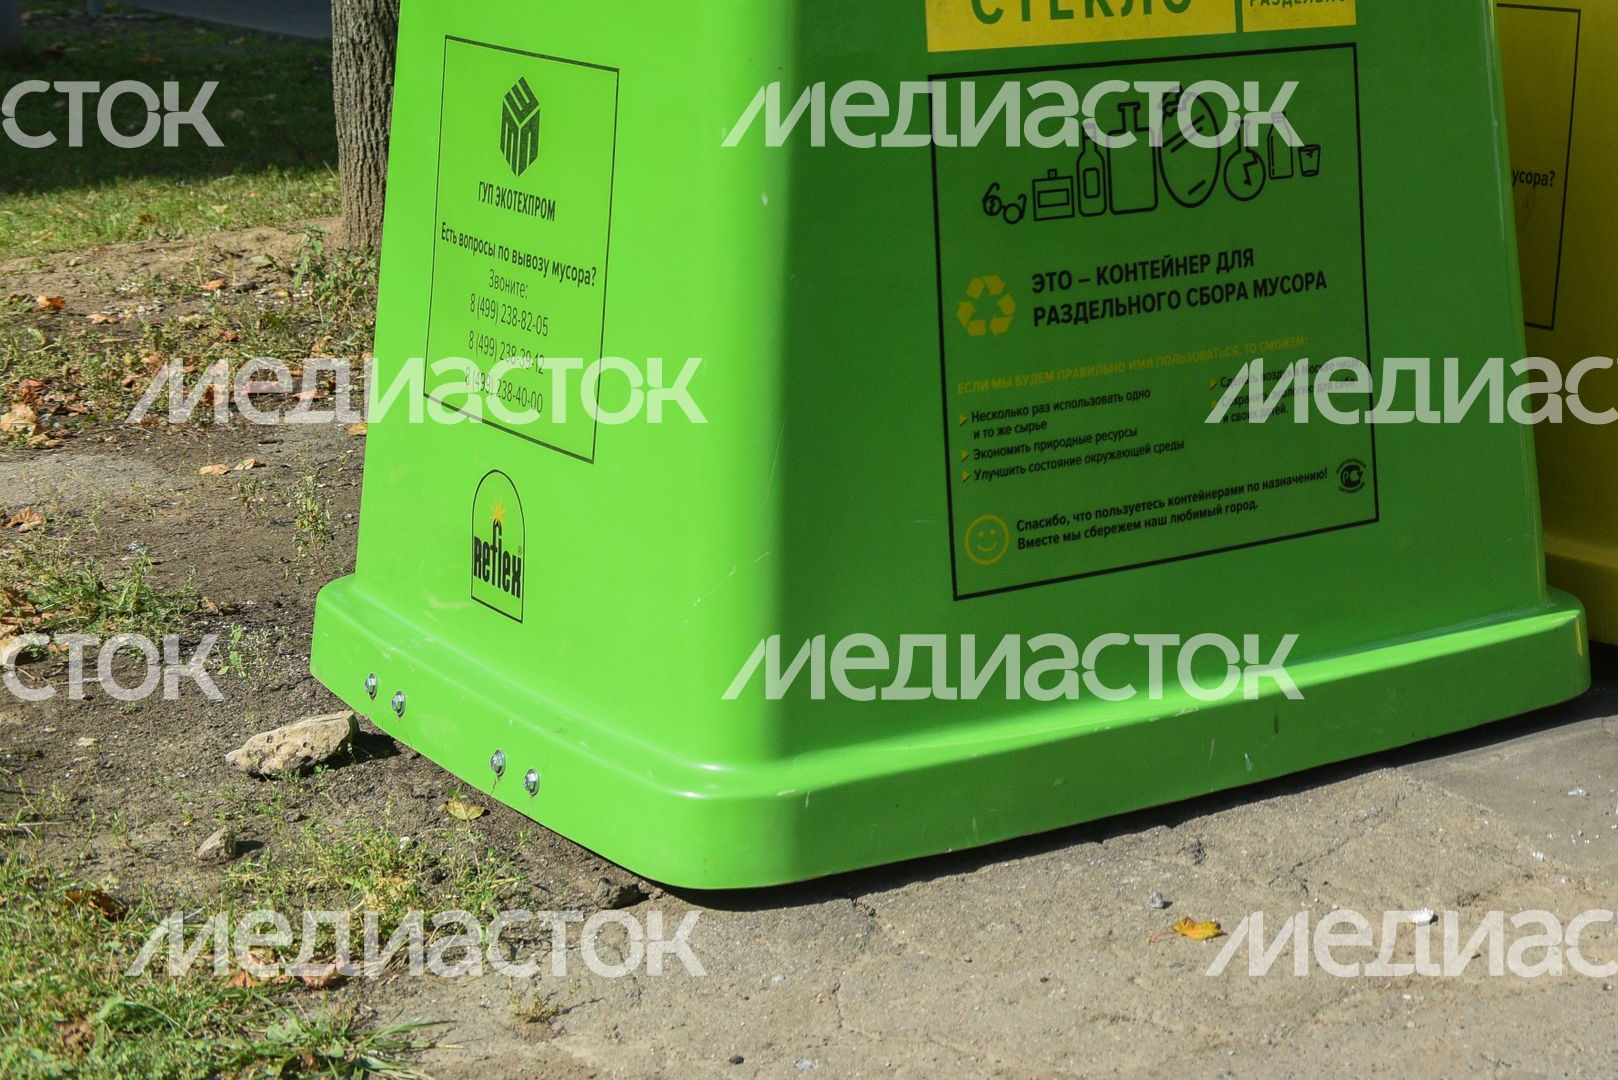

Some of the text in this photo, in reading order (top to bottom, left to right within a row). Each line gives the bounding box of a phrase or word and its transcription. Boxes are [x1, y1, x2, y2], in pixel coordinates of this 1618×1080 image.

[1511, 169, 1556, 189] усора?
[478, 181, 555, 221] ГУП ЭКОТЕХПРОМ
[441, 221, 597, 287] Есть вопросы по вывозу мусора?
[1032, 247, 1253, 293] ЭТО КОНТЕЙНЕР ДЛЯ
[489, 268, 527, 298] Звоните:
[1033, 270, 1326, 326] РАЗДЕЛЬНОГО СБОРА МУСОРА
[470, 293, 548, 336] 8 (499) 238-82-05
[468, 330, 545, 375] 8 (499) 238-39-12
[497, 379, 543, 414] 238-40-00
[971, 389, 1150, 422] Несколько раз использовать одно
[973, 420, 1047, 439] и то же сырье
[973, 427, 1137, 460] Экономить природные ресурсы
[974, 440, 1184, 481] Улучшить состояние окружающей среды
[1016, 513, 1069, 531] Спасибо,
[1072, 511, 1091, 521] что
[1095, 499, 1164, 519] пользуетесь
[1167, 485, 1244, 506] контейнерами
[1247, 482, 1259, 492] по
[1262, 467, 1327, 489] назначению!
[1017, 500, 1257, 549] Вместе мы сбережем наш любимый город.
[473, 518, 522, 599] Reflex
